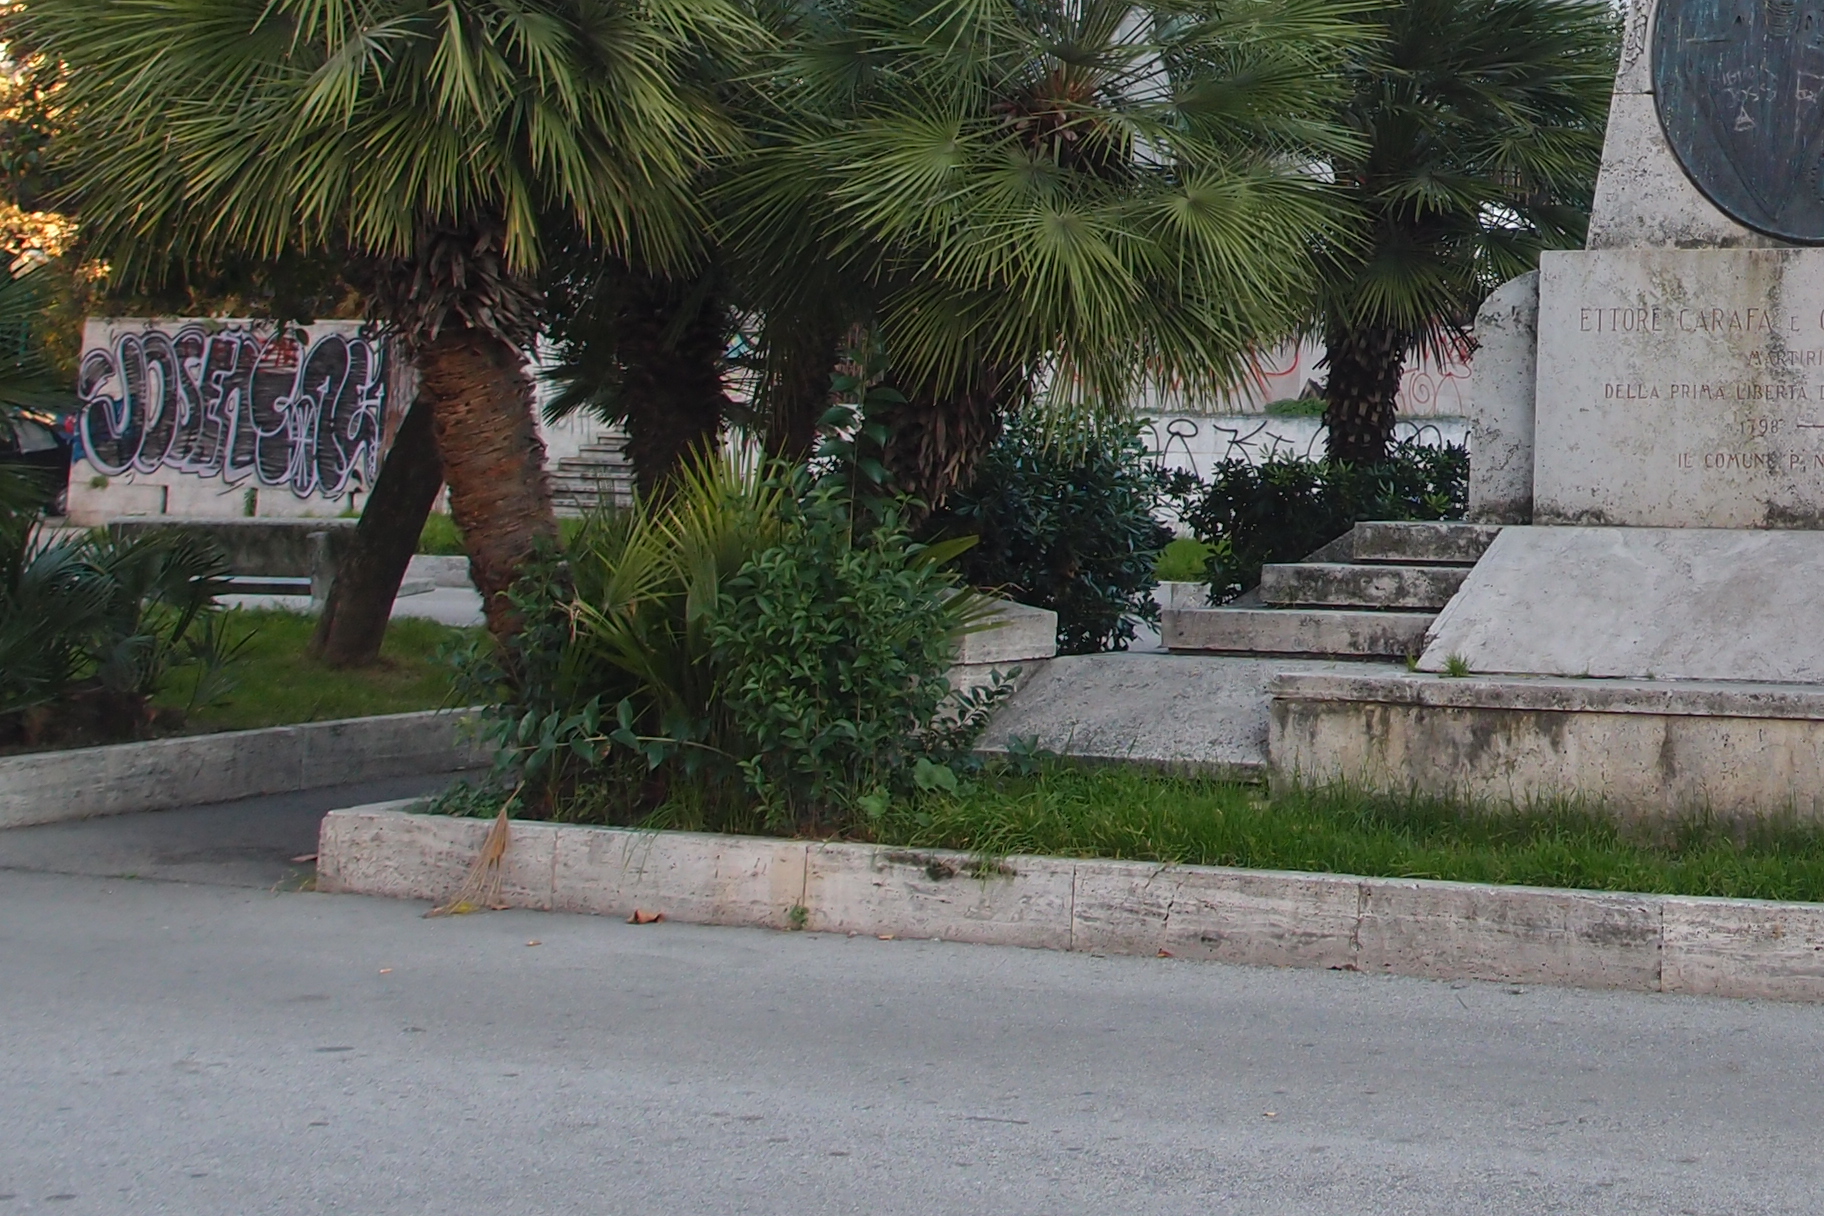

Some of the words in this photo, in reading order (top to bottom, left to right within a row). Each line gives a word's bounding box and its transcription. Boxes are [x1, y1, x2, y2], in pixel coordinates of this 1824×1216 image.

[1580, 308, 1663, 332] ETTORE
[1679, 308, 1773, 332] CARAFA
[1750, 350, 1823, 366] MARTIRI
[1605, 383, 1660, 400] DELLA
[1670, 383, 1725, 400] PRIMA
[1739, 419, 1779, 434] 1798
[1678, 453, 1693, 468] IL
[1704, 453, 1776, 469] COMUNE
